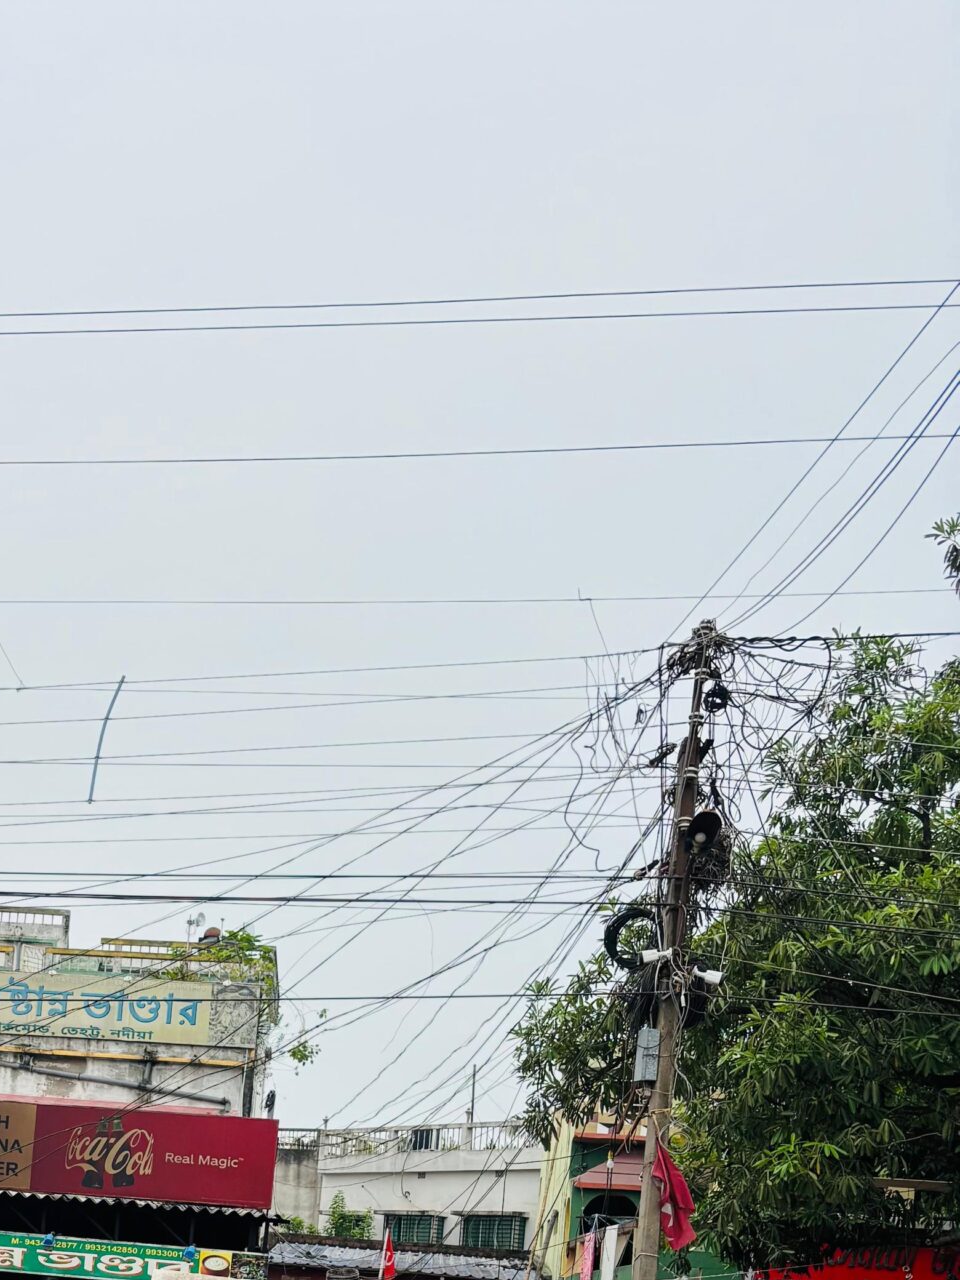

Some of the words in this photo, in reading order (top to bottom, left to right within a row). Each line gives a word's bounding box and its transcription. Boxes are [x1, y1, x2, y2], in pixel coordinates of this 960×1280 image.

[81, 992, 202, 1027] ভাণ্ডার
[165, 1152, 195, 1165] Real
[85, 1243, 138, 1254] 9932142850
[145, 1248, 199, 1261] 99330015
